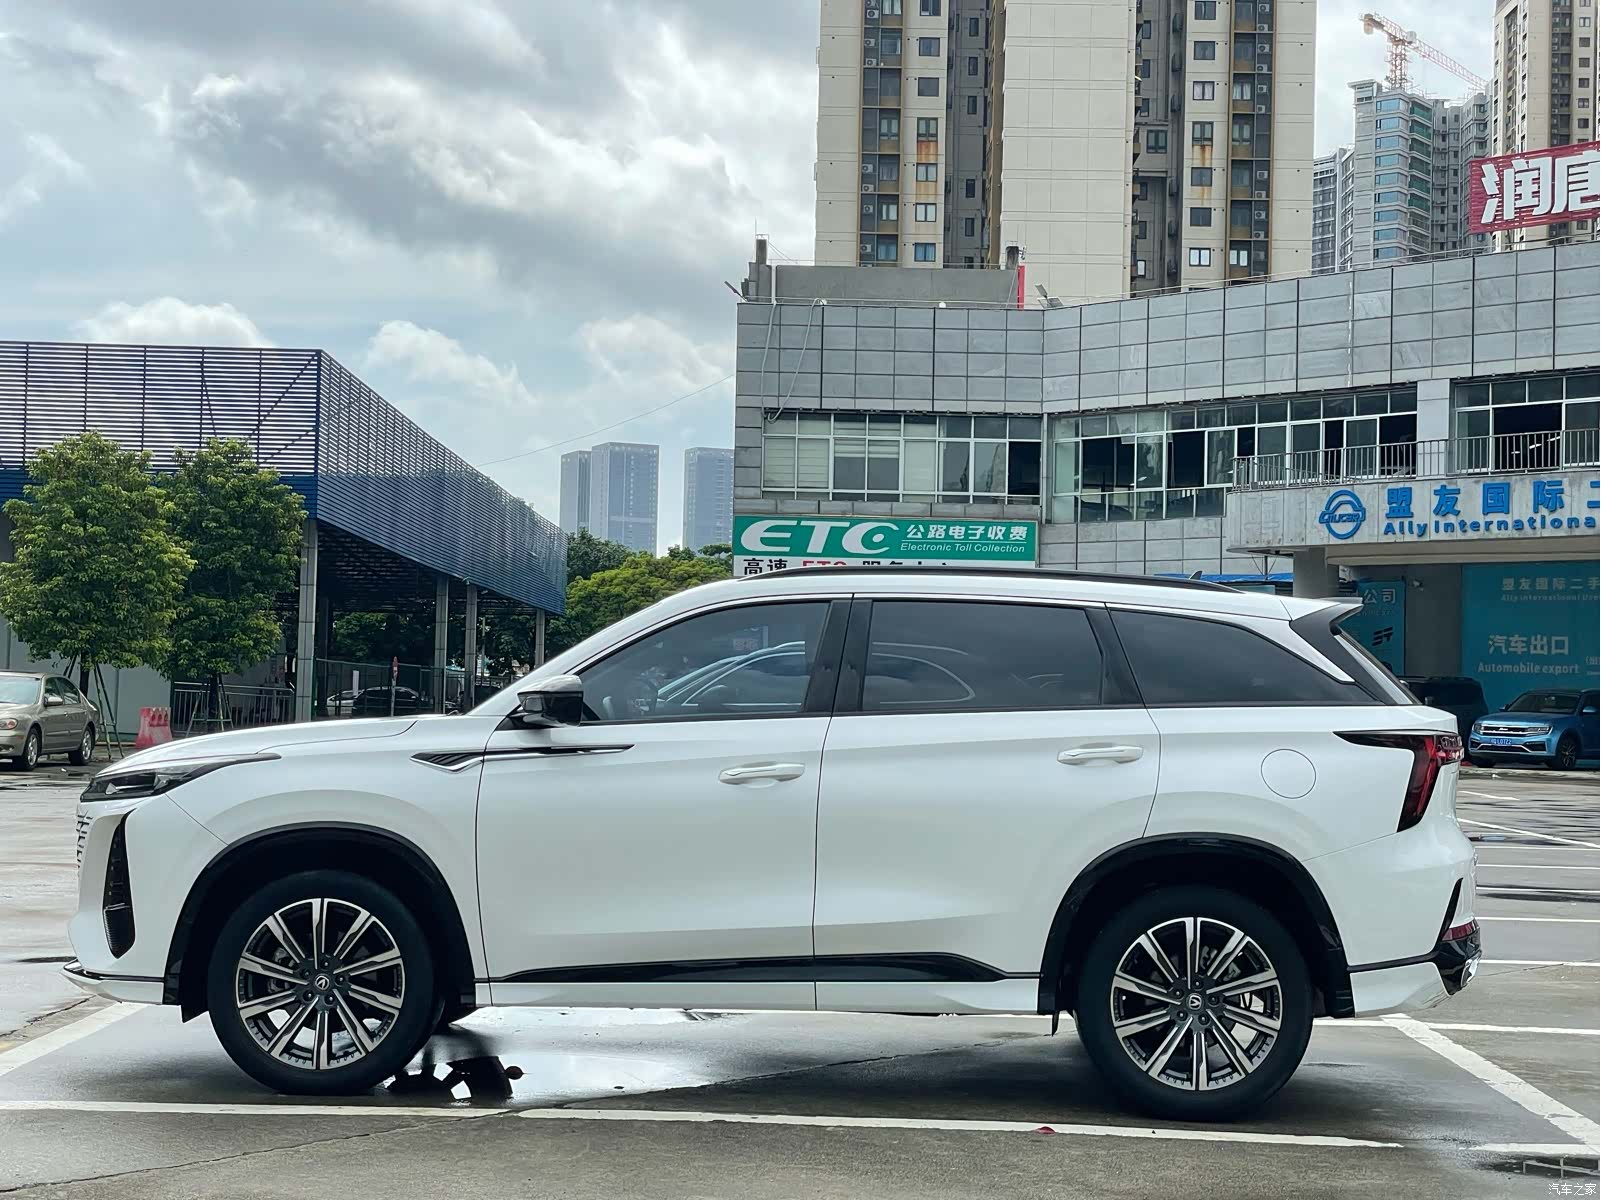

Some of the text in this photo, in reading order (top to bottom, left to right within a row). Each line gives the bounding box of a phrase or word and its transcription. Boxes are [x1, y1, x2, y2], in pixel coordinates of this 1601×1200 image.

[740, 519, 899, 554] ETC
[906, 524, 1028, 541] 公路电子收费
[1383, 521, 1428, 537] Ally
[900, 542, 1025, 553] Electronic Toll Collection
[1488, 634, 1569, 655] 汽车出口
[1478, 662, 1579, 676] Automobile export
